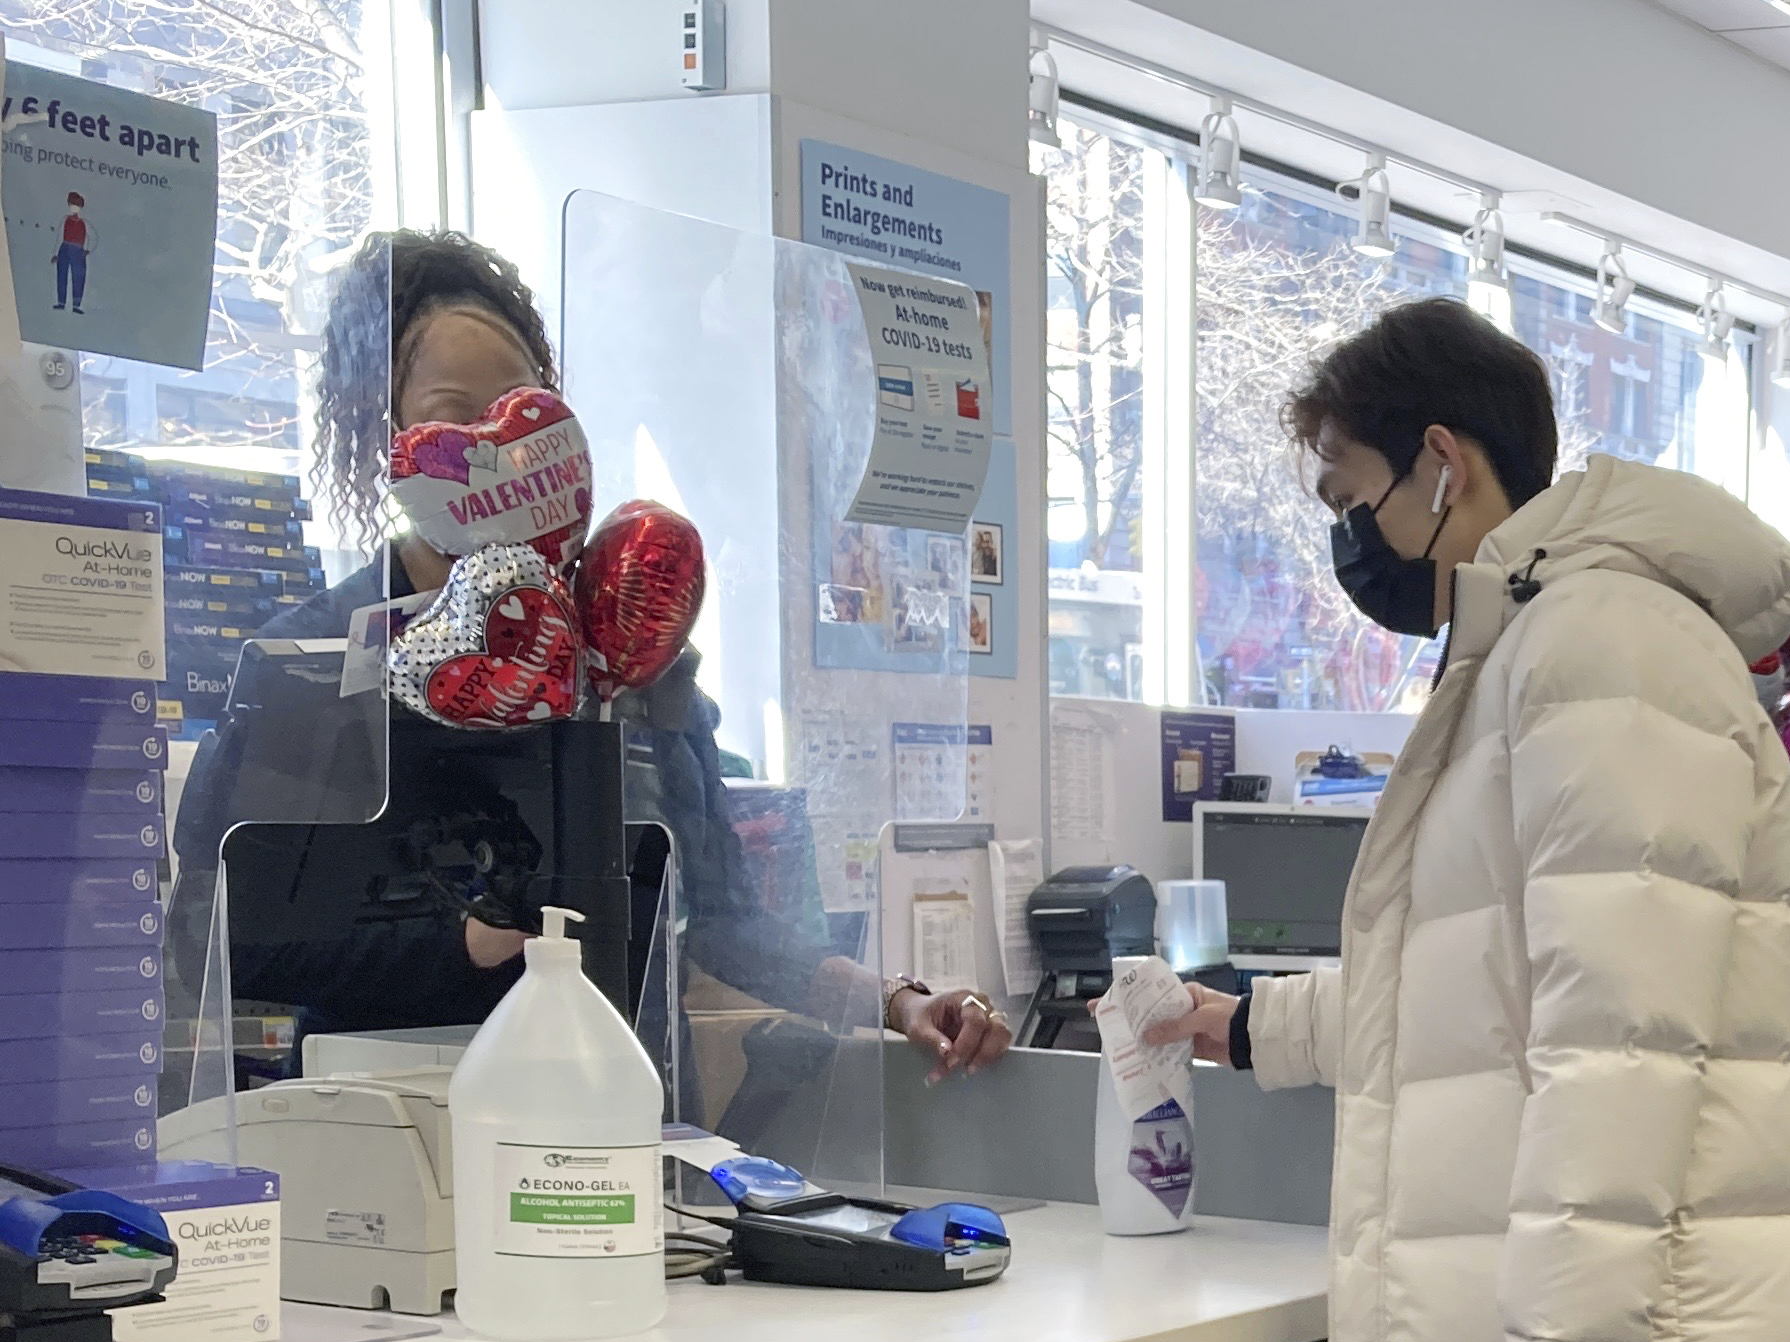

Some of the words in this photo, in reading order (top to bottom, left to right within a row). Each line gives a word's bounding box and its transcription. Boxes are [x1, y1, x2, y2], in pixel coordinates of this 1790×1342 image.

[47, 99, 111, 142] feet
[119, 124, 200, 163] apart
[38, 147, 95, 173] protect
[98, 162, 172, 190] everyone.
[821, 163, 878, 198] Prints
[882, 184, 913, 208] and
[821, 194, 943, 246] Enlargements
[821, 225, 888, 254] Impresiones
[890, 243, 897, 258] y
[898, 245, 961, 272] ampliaciones
[860, 277, 885, 294] Now
[887, 283, 905, 299] get
[906, 286, 967, 311] reimbursed!
[895, 304, 950, 331] At-home
[881, 327, 940, 354] COVID-19
[942, 339, 973, 361] tests
[507, 427, 572, 473] HAPPY
[144, 511, 155, 525] 2
[530, 498, 571, 531] DAY
[55, 536, 152, 563] QuickVue
[83, 560, 152, 578] At-Home
[180, 572, 206, 583] NOW
[70, 575, 127, 590] COVID-19
[193, 625, 217, 637] NOW
[449, 658, 497, 720] HAPPY
[264, 1181, 274, 1194] 2
[533, 1179, 616, 1192] ECONO-GEL
[520, 1197, 560, 1208] ALCOHOL
[561, 1198, 609, 1208] ANTISEPTIC
[178, 1215, 272, 1241] QuickVue
[542, 1213, 572, 1221] TOPICAL
[204, 1236, 271, 1251] At-Home
[191, 1253, 245, 1268] COVID-19
